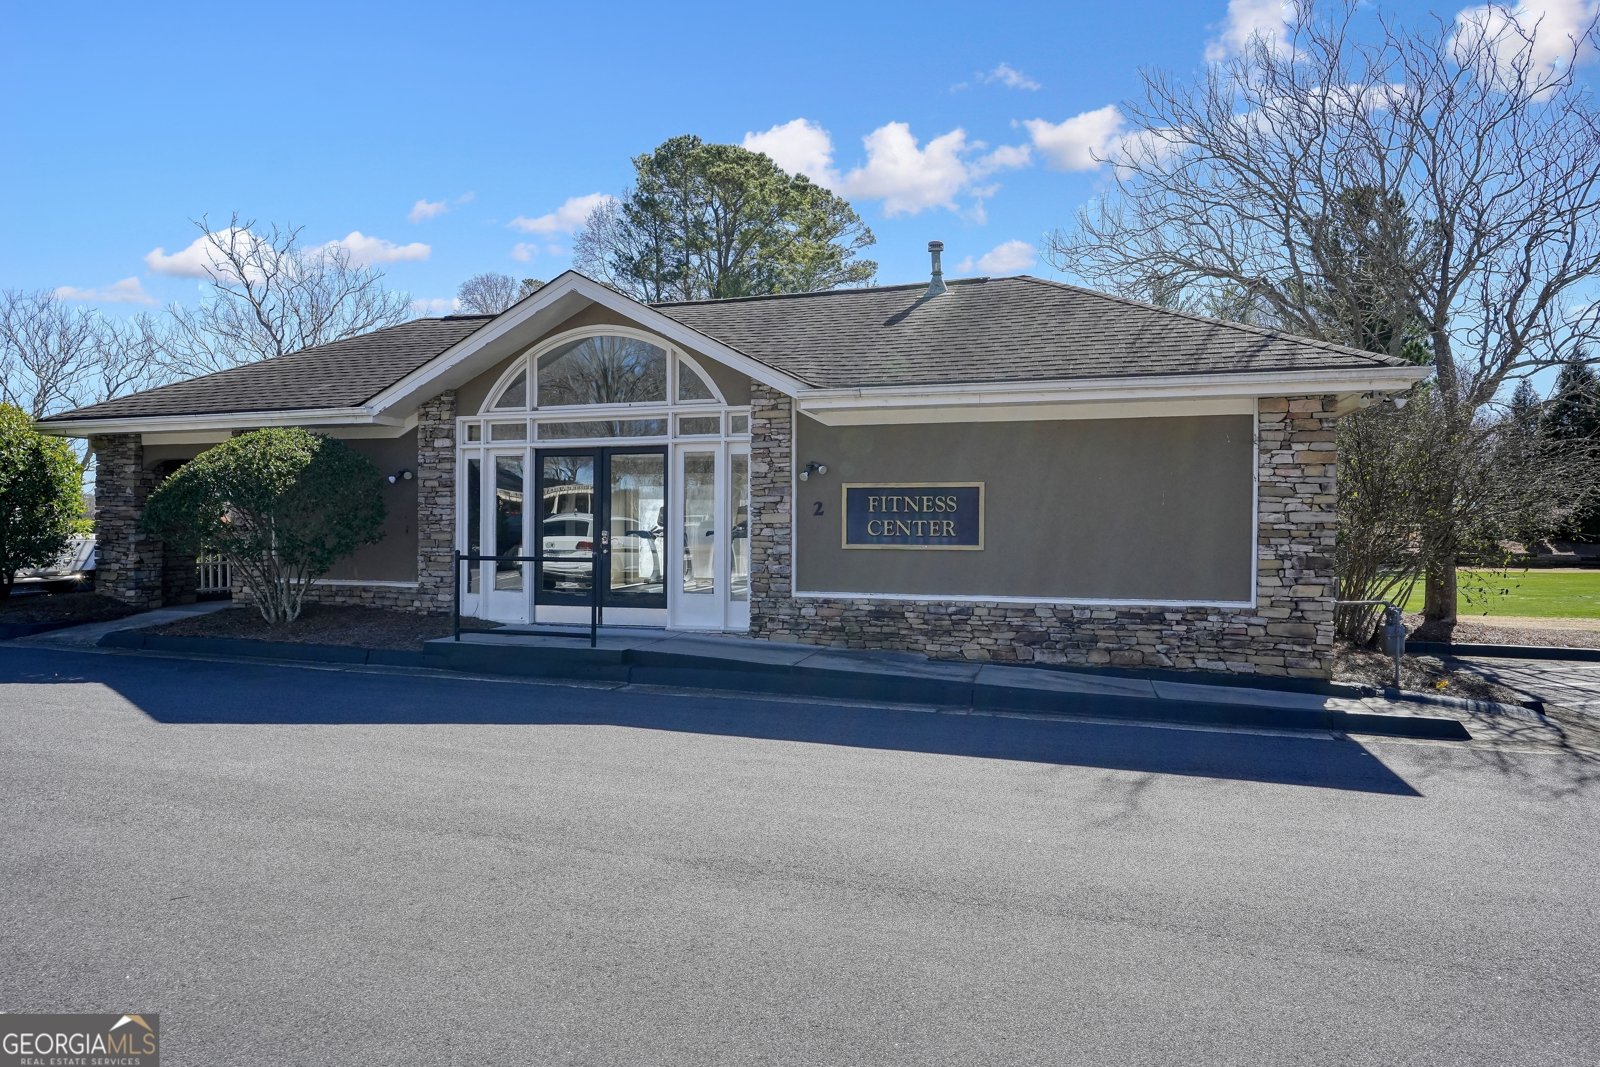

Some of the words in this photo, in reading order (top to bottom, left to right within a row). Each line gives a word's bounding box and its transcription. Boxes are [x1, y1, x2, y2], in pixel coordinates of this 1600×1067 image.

[813, 501, 824, 516] 2
[868, 495, 957, 513] FITNESS
[867, 519, 956, 537] CENTER
